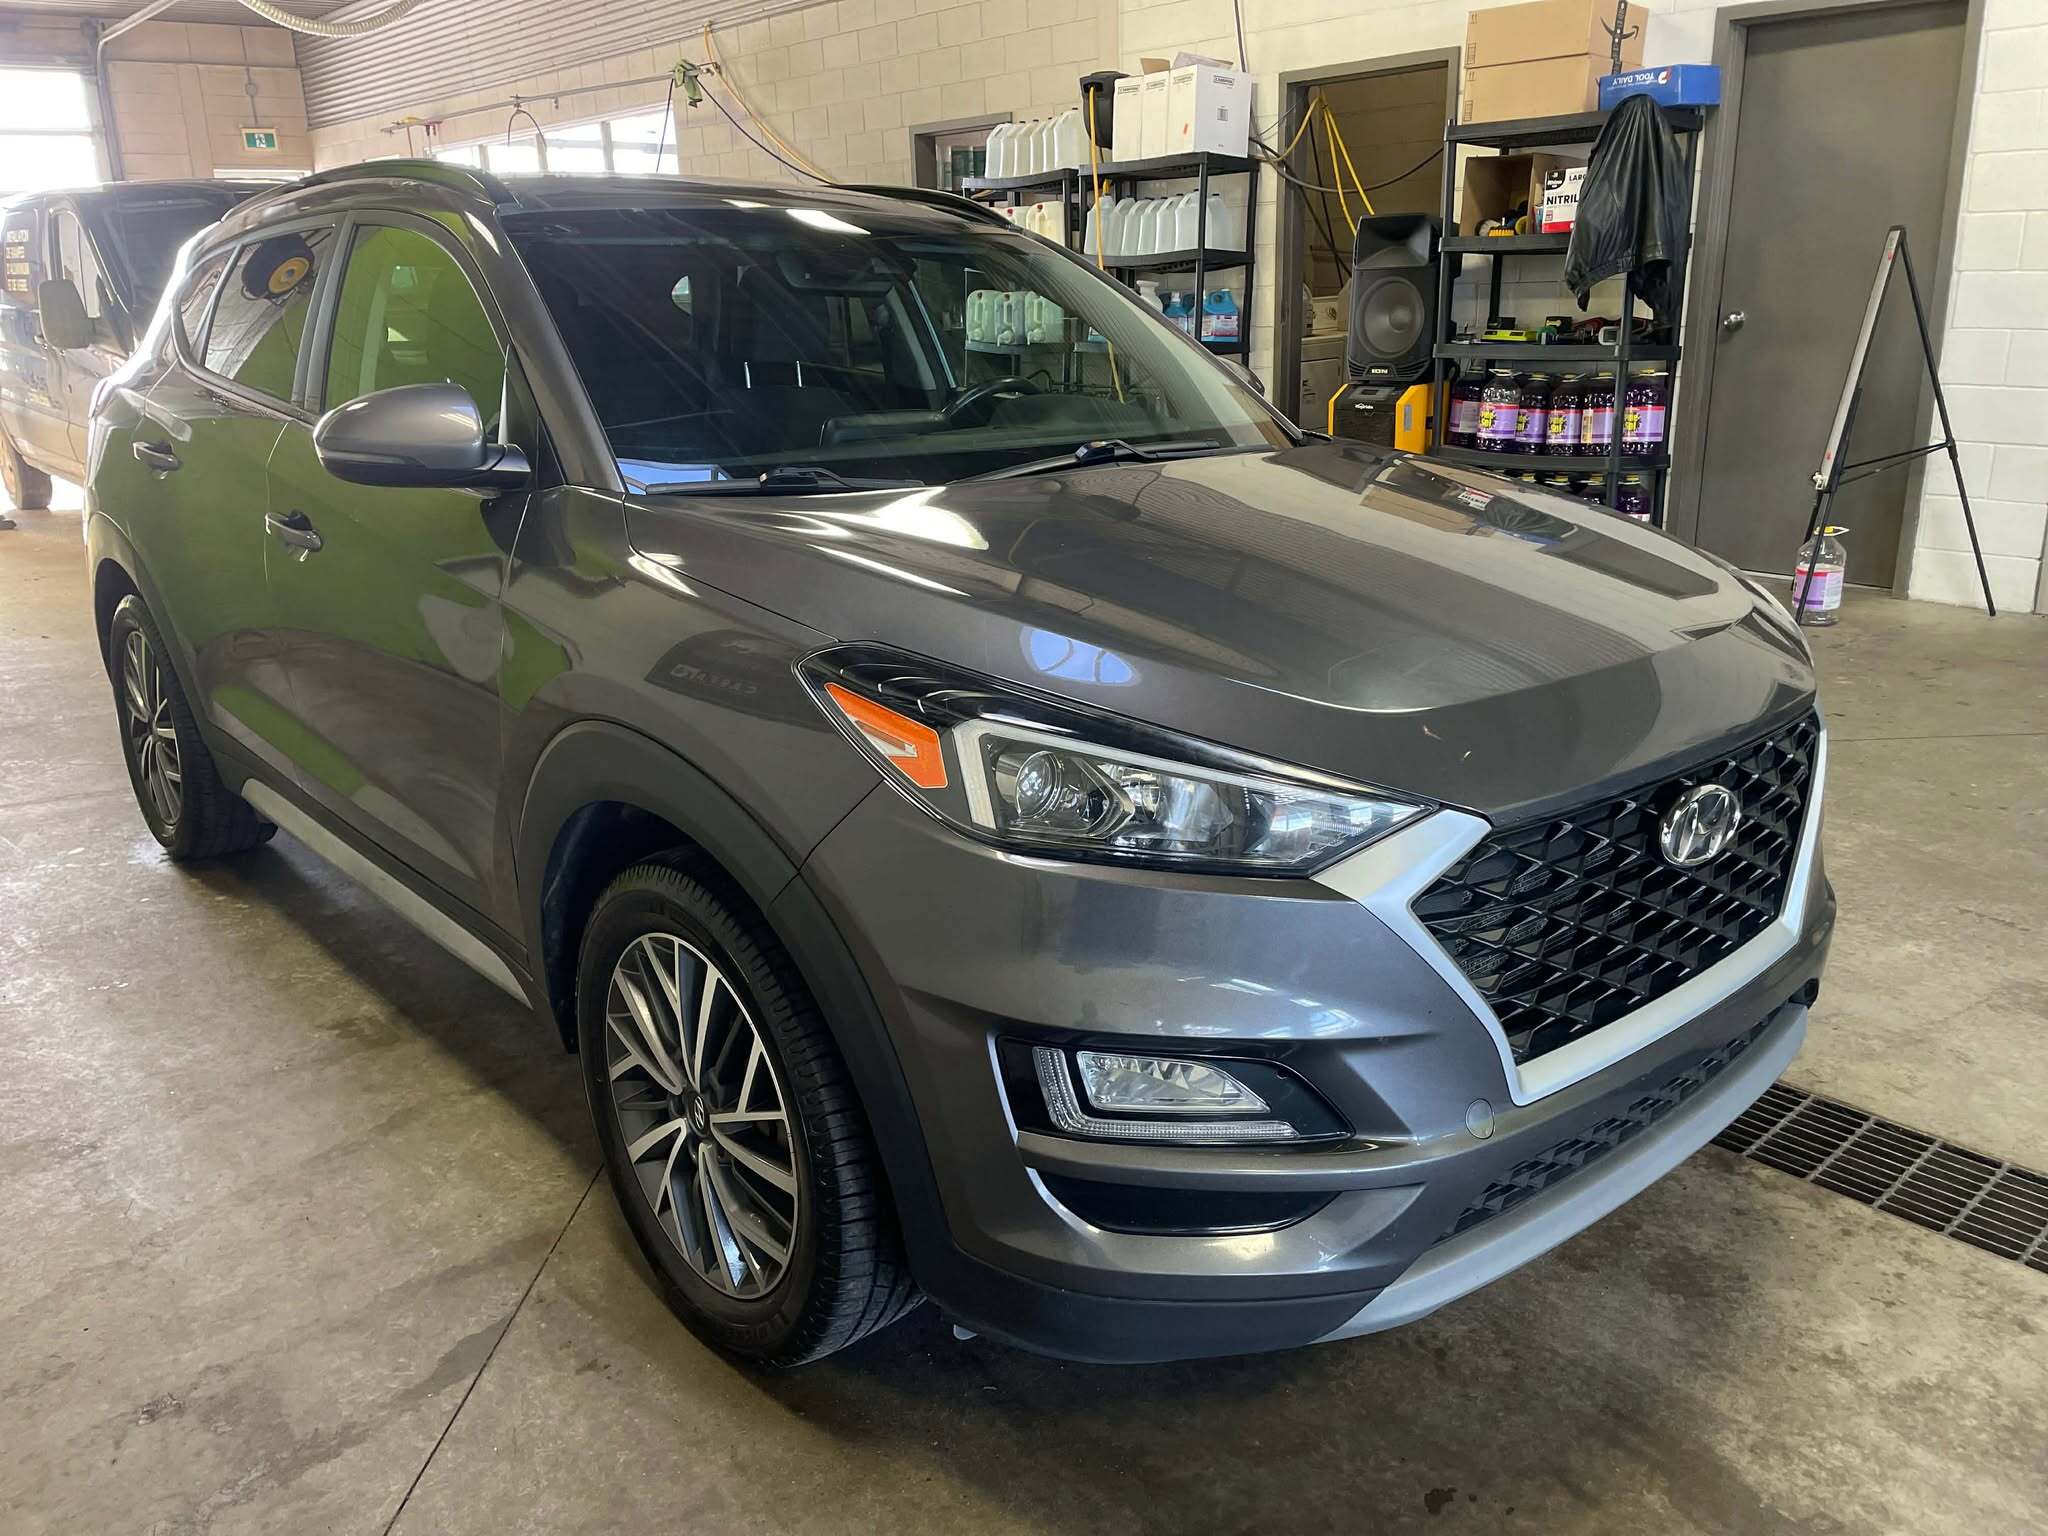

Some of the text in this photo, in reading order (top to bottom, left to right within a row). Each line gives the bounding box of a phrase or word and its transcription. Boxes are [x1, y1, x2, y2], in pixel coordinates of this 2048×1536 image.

[1612, 75, 1633, 86] DAILY
[1635, 72, 1655, 82] TOOL
[1546, 194, 1578, 205] NITRIL
